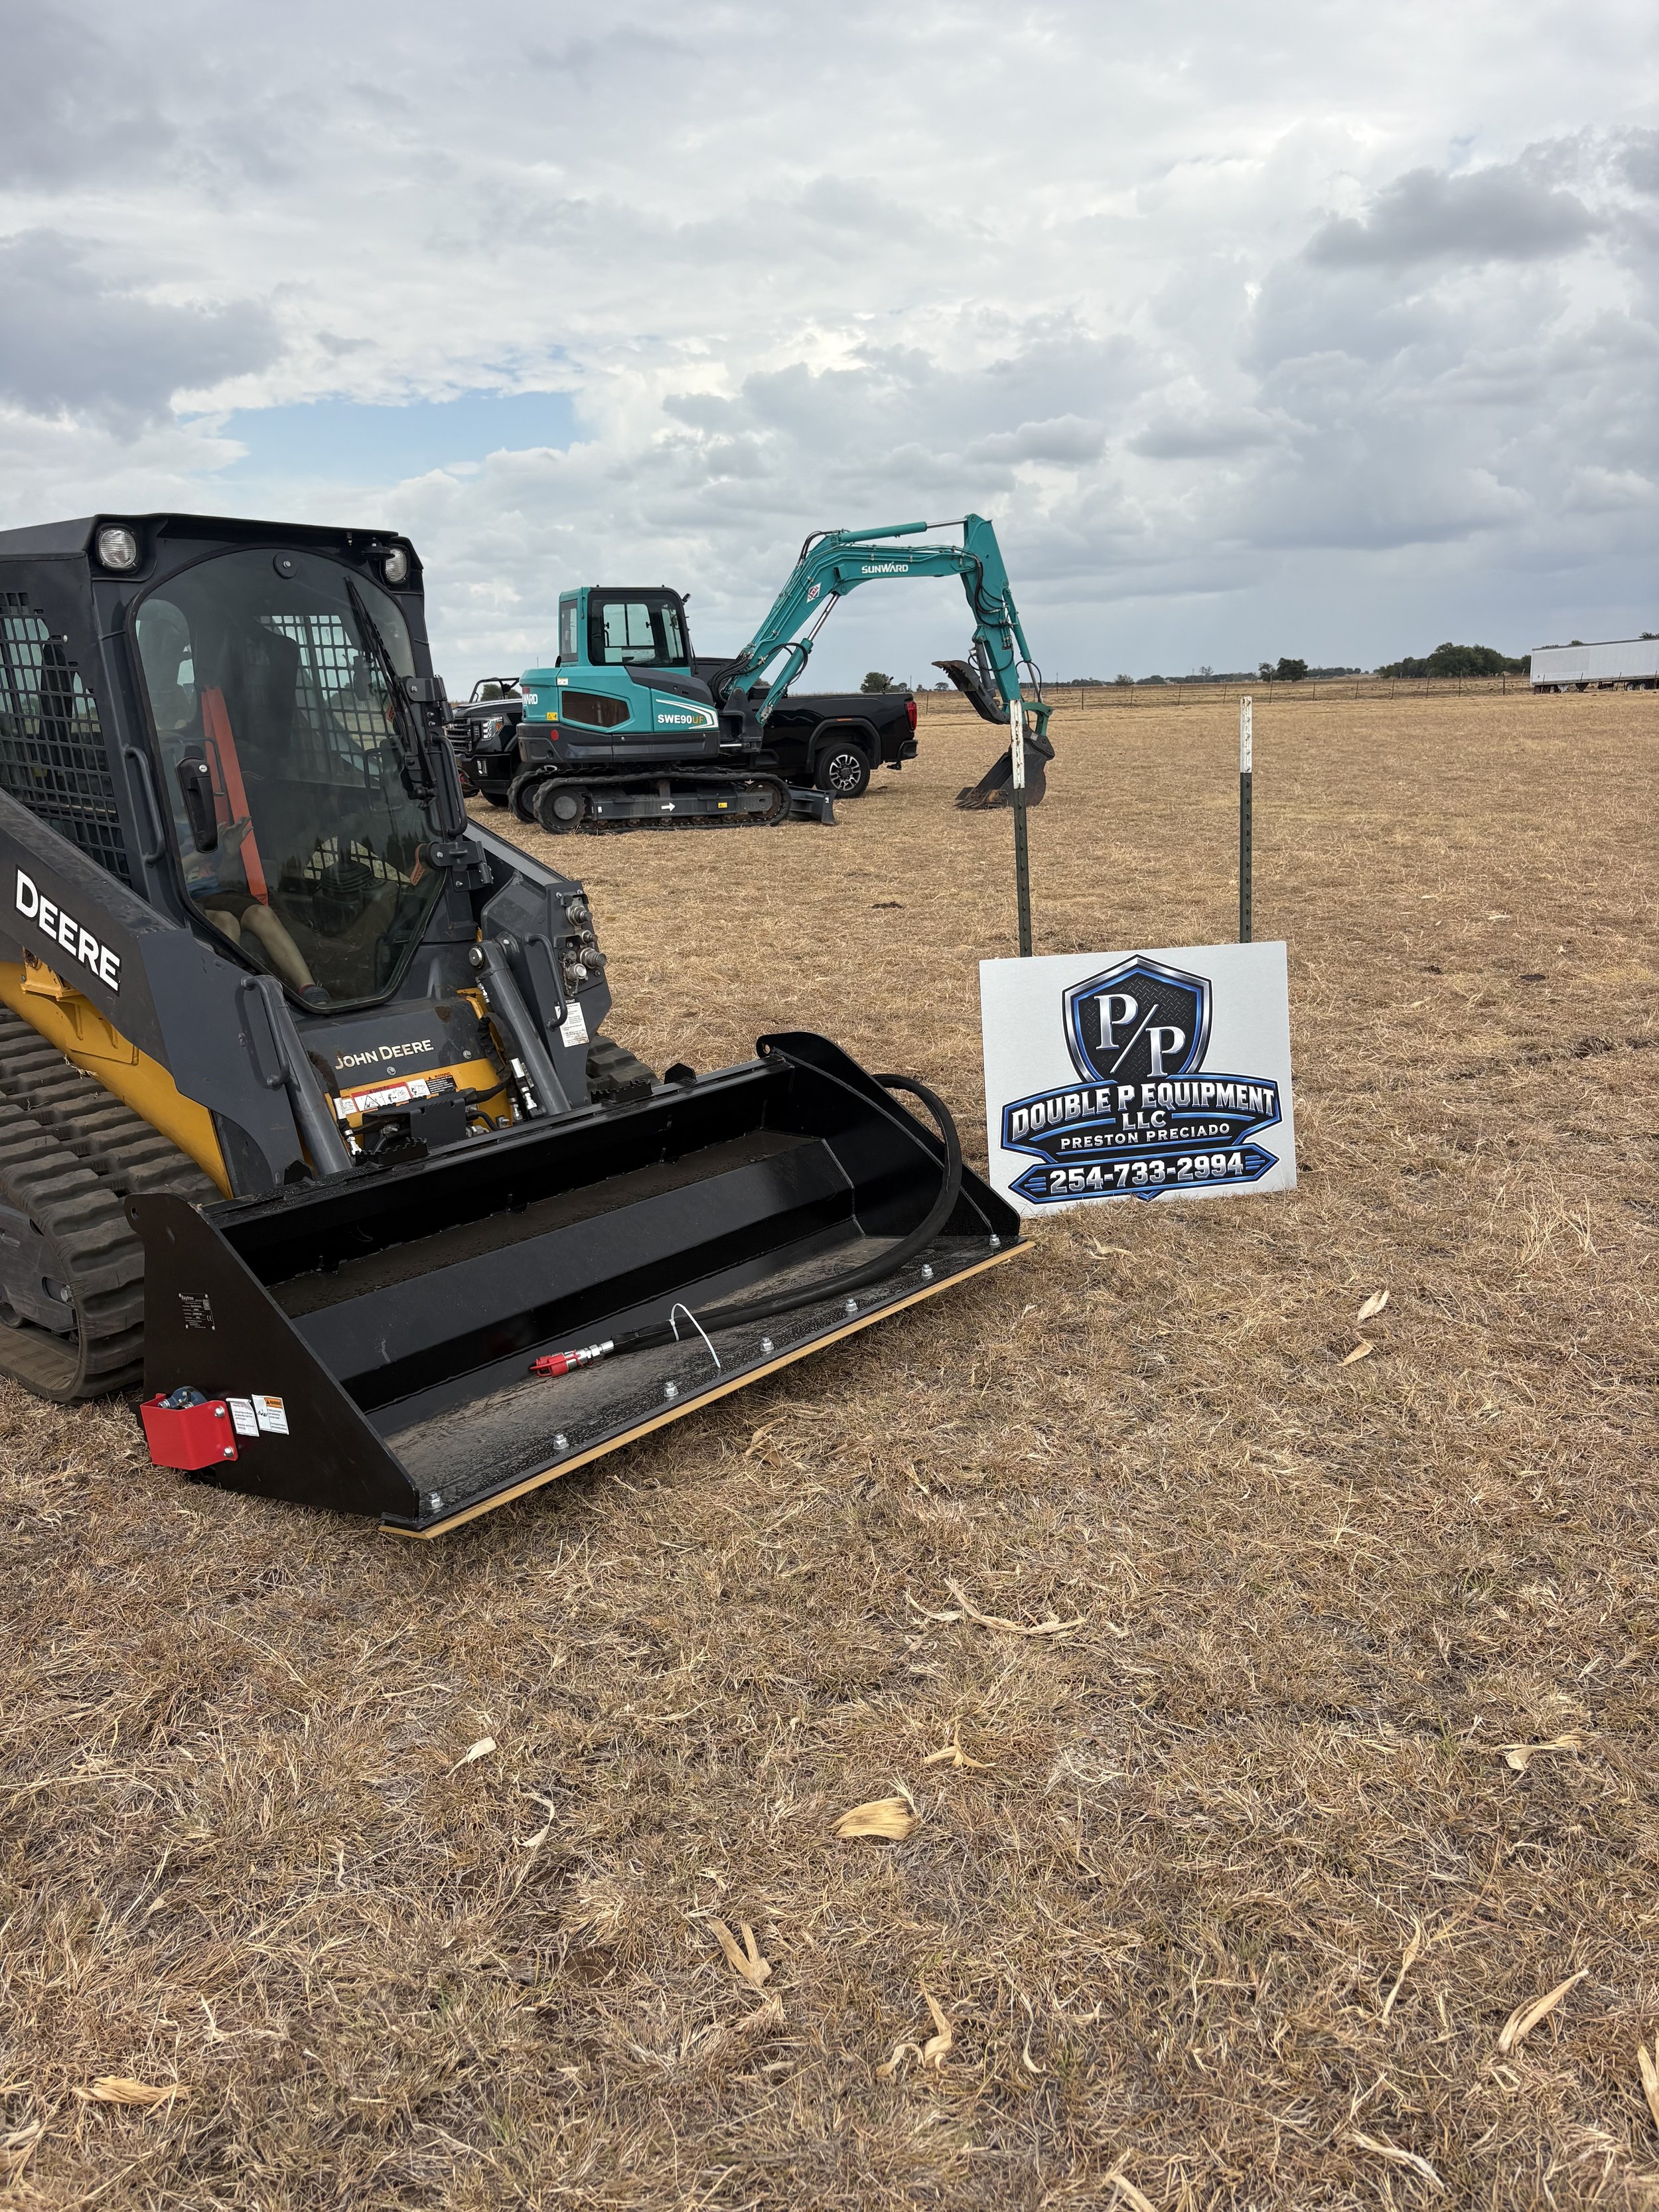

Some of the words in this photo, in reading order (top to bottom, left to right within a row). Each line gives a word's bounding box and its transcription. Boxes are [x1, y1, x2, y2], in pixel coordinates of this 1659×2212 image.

[861, 561, 908, 573] SUNWARD
[658, 714, 703, 724] SWE90UF
[15, 869, 121, 992] DEERE
[334, 1051, 379, 1070] JOHN
[378, 1039, 434, 1061] DEERE
[1011, 1087, 1112, 1142] DOUBLE
[1116, 1084, 1136, 1112] P
[1141, 1081, 1275, 1118] EQUIPMENT
[1121, 1110, 1167, 1131] LLC
[1060, 1132, 1139, 1149] PRESTON
[1146, 1123, 1230, 1142] PRECIADO
[1050, 1151, 1244, 1194] 254-733-2994
